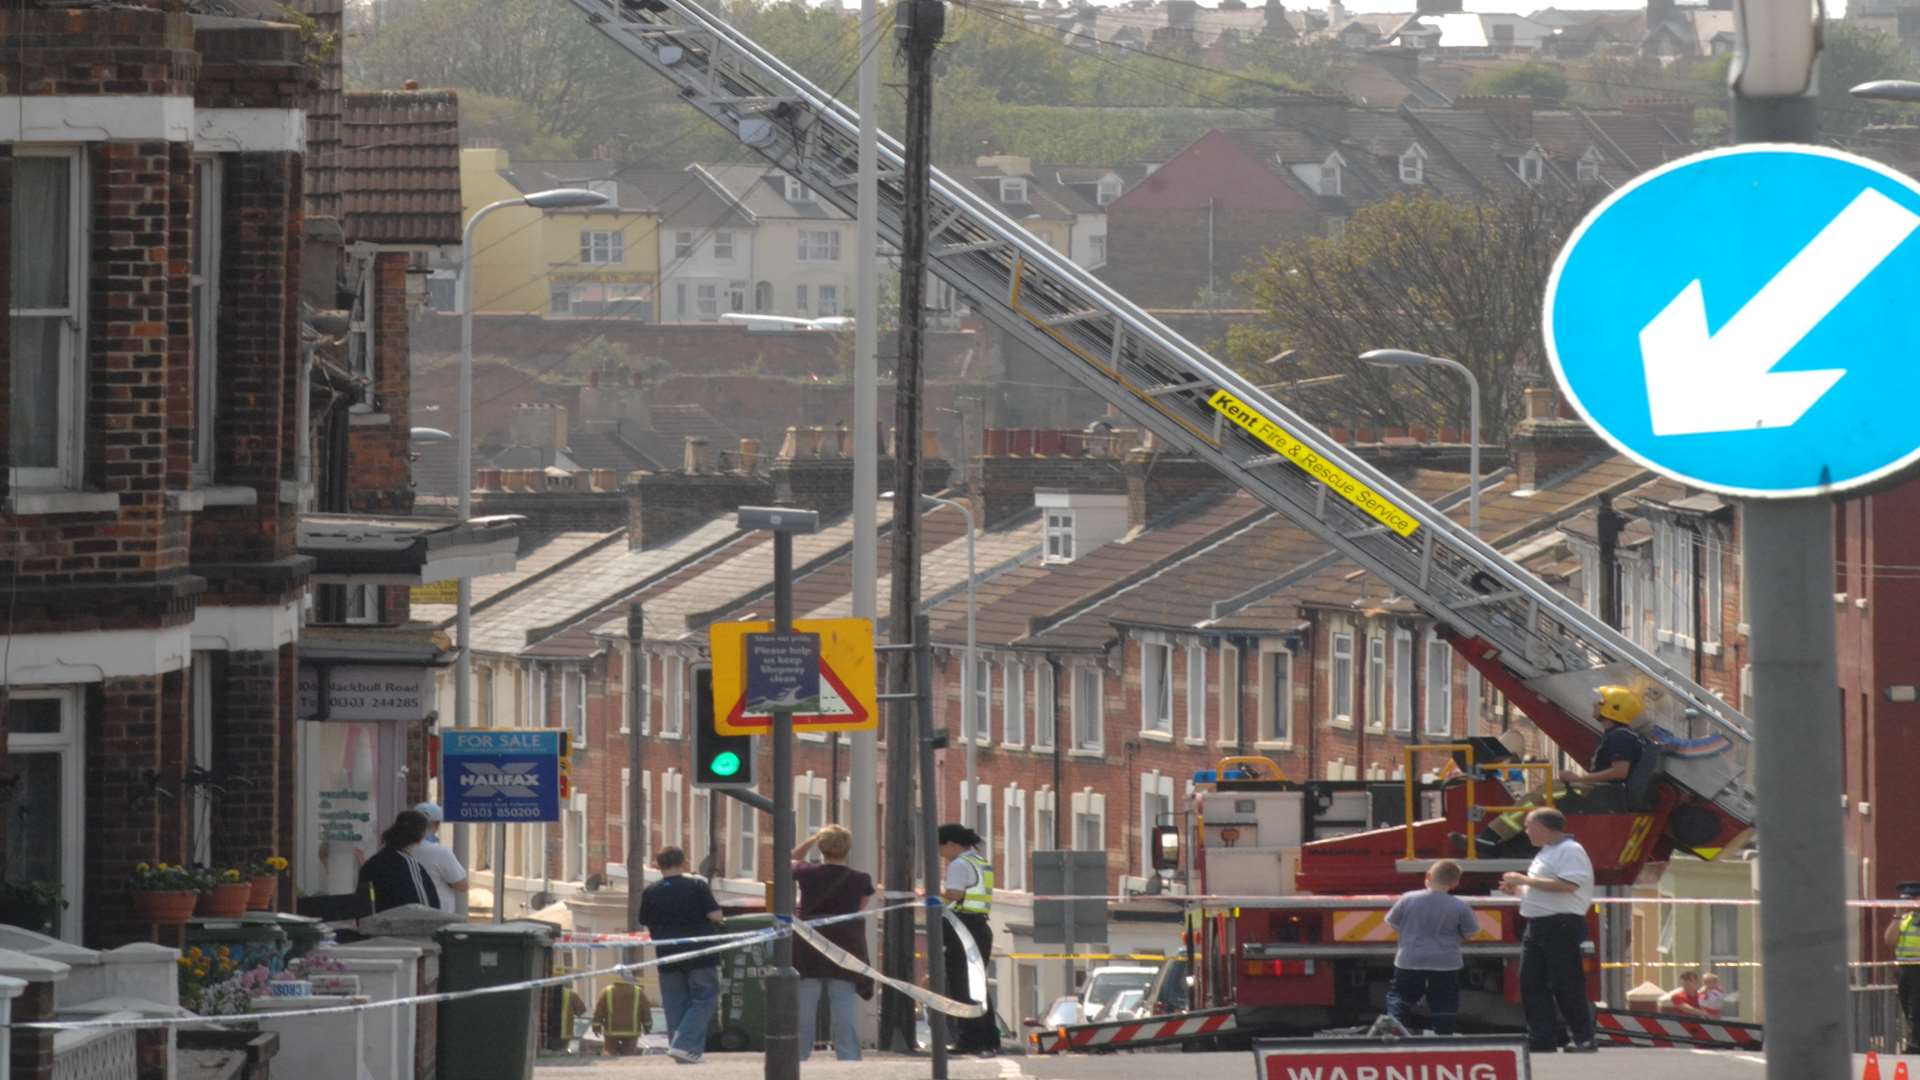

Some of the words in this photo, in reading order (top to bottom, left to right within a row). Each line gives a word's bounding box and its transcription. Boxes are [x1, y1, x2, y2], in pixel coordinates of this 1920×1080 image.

[1215, 395, 1258, 428] Kent
[1259, 423, 1287, 448] Fire
[1288, 444, 1302, 458] &
[1302, 453, 1355, 494] Rescue
[1356, 490, 1409, 530] Service
[754, 646, 787, 655] Please
[789, 646, 812, 656] help
[777, 656, 803, 666] keep
[769, 675, 797, 683] clean
[329, 681, 382, 692] lackbull
[385, 681, 419, 692] Road
[371, 697, 419, 708] 244285
[457, 735, 494, 748] FOR
[499, 735, 541, 748] SALE
[460, 774, 541, 786] HALIFAX
[1286, 1063, 1498, 1080] WARNING
